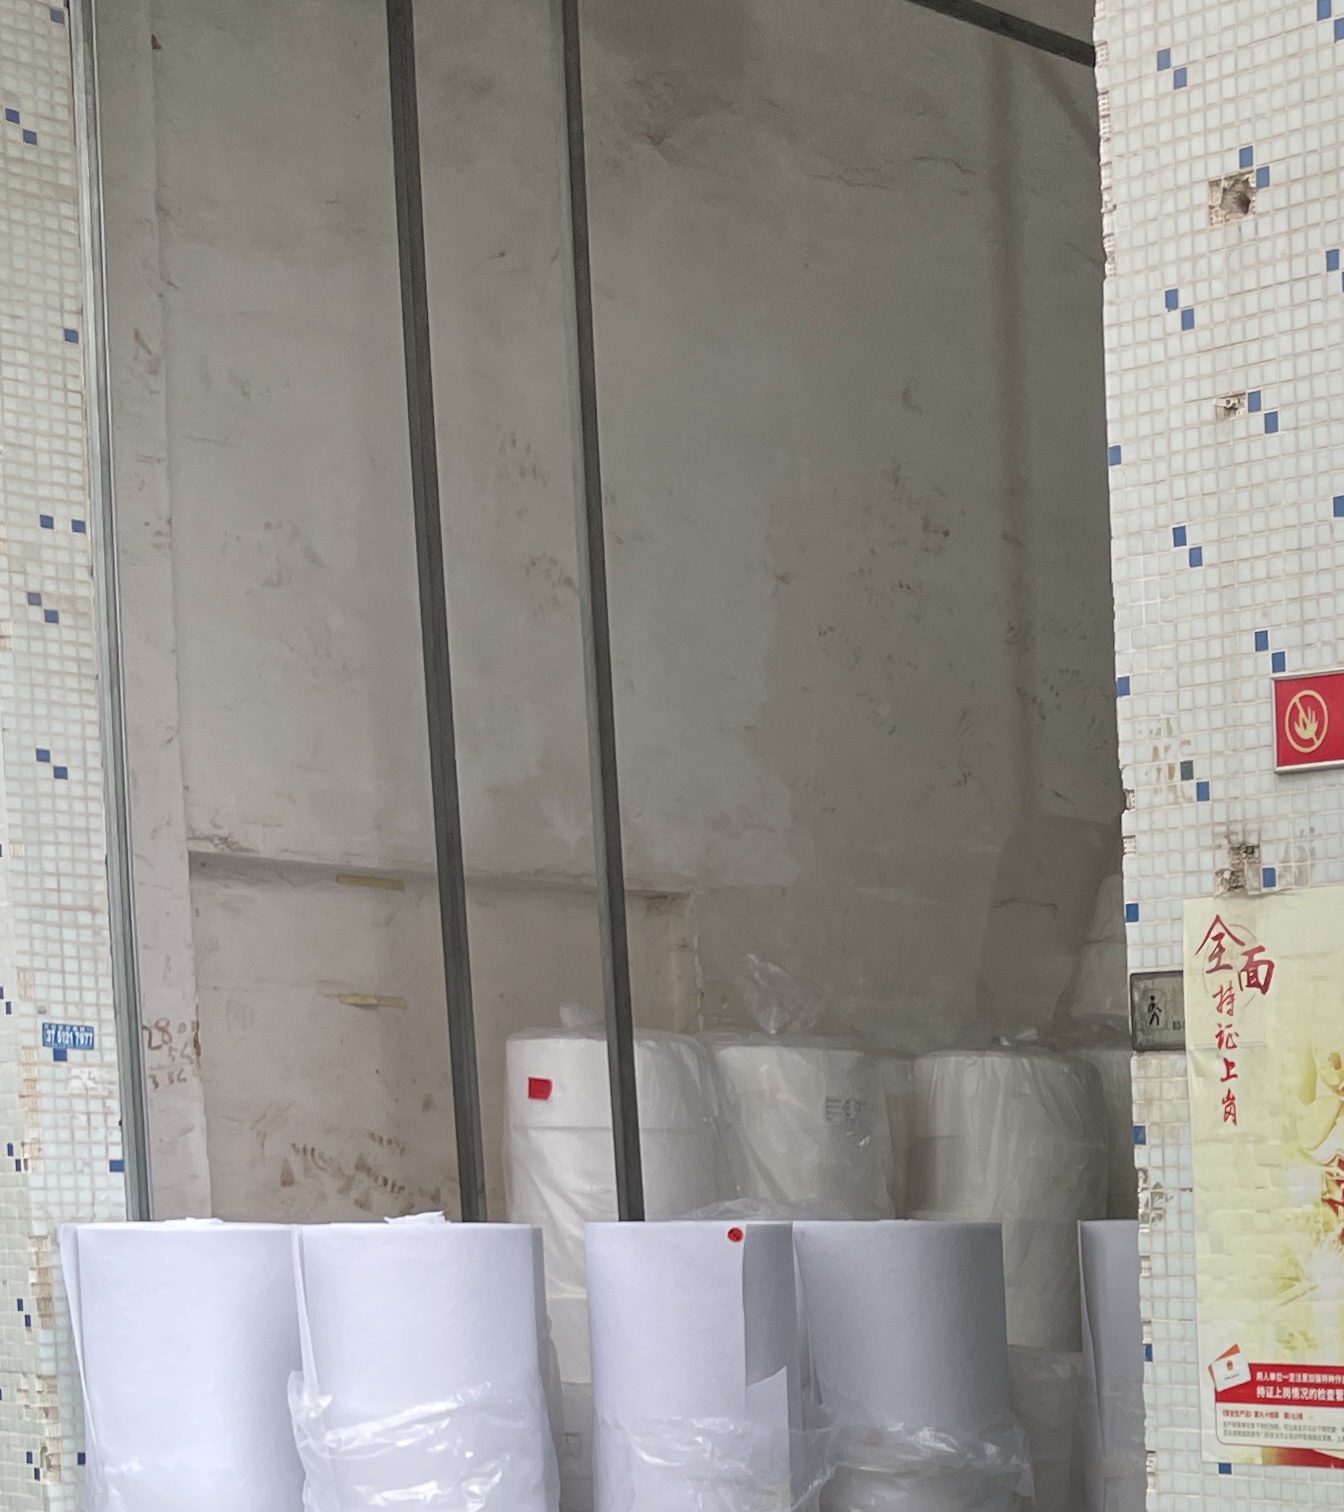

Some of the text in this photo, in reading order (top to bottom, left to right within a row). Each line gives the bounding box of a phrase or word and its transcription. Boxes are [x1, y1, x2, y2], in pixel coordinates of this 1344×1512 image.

[1194, 914, 1275, 995] 全面
[1212, 980, 1239, 1126] 持证上岗
